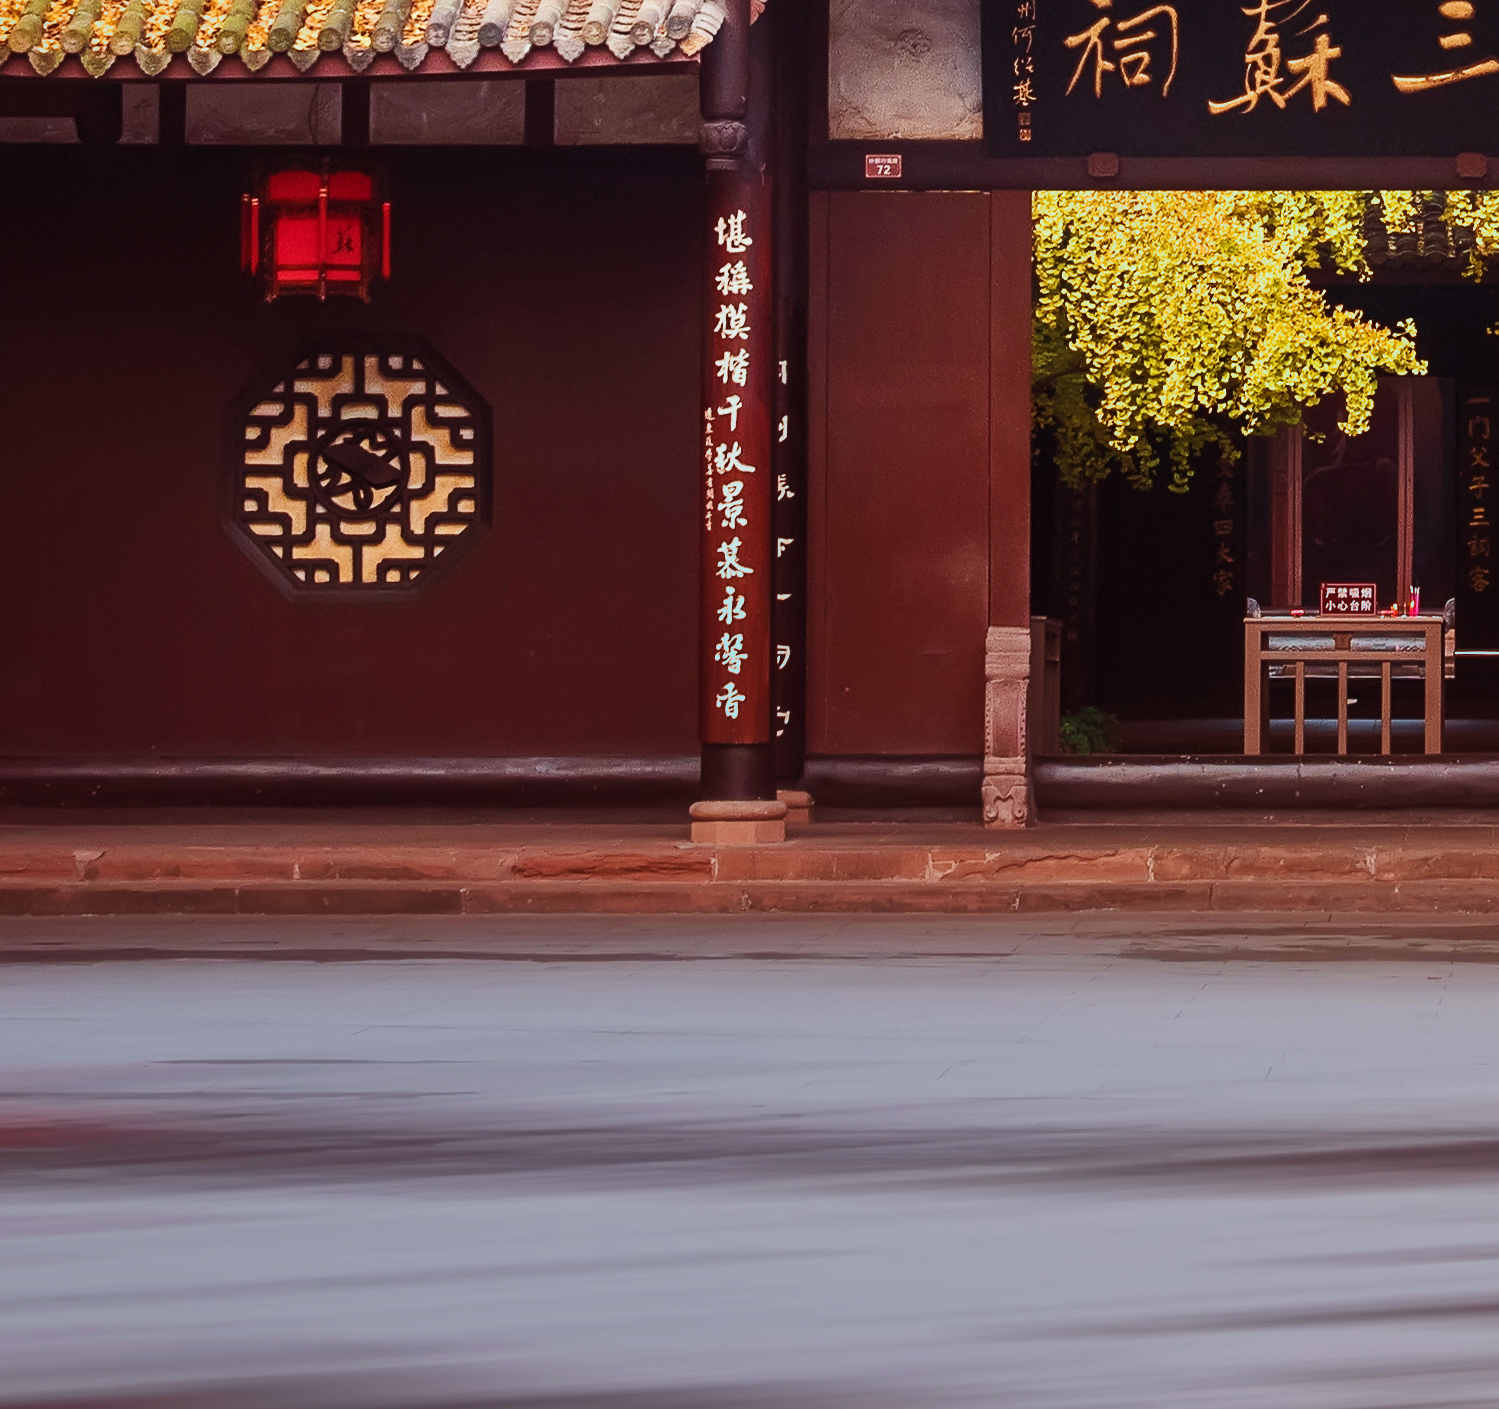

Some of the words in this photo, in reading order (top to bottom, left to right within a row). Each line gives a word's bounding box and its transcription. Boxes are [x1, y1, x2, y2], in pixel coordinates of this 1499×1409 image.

[876, 164, 891, 175] 72
[1325, 587, 1373, 599] 严禁吸烟
[1325, 599, 1372, 612] 小心台阶
